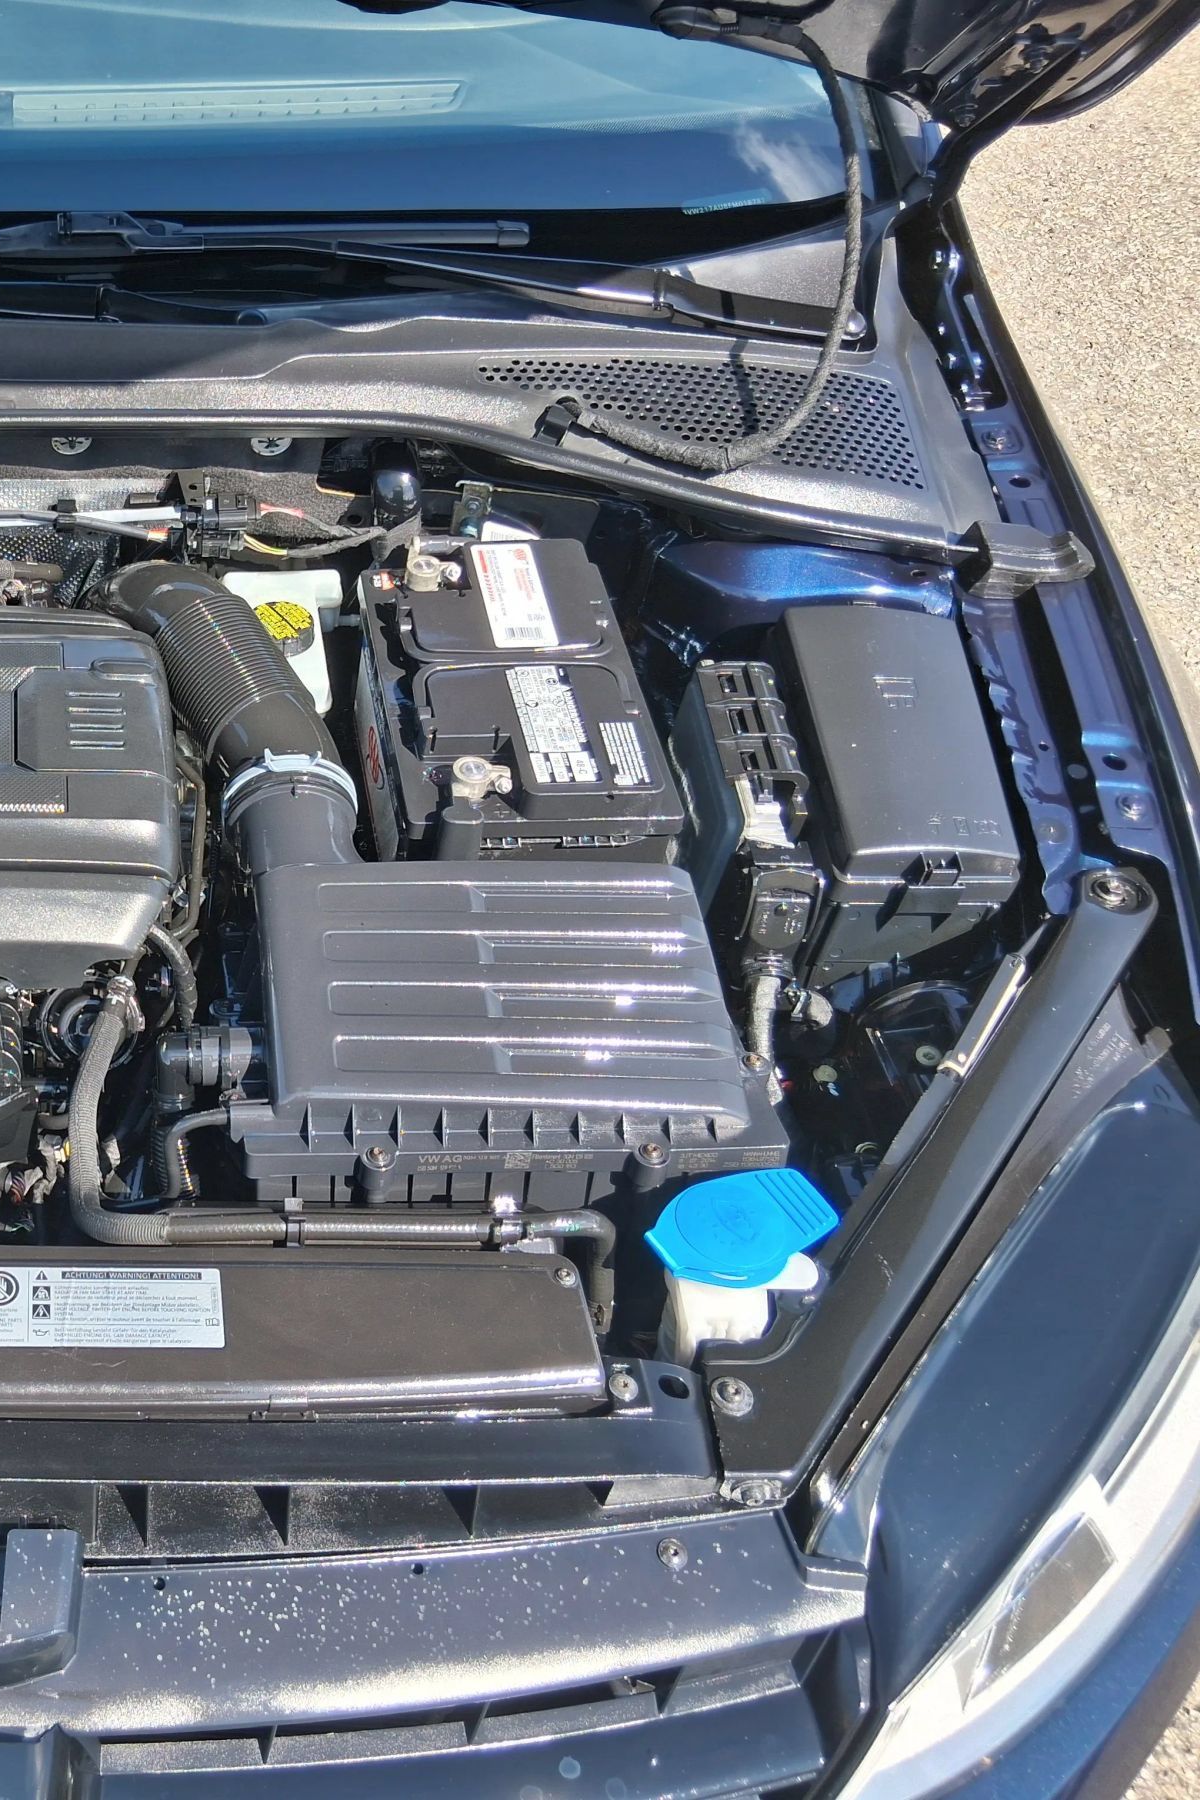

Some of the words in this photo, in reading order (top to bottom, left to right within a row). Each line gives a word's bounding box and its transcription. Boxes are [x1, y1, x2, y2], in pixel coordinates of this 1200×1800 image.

[64, 1271, 107, 1279] ACHTUNG!
[108, 1272, 151, 1280] WARNING!
[152, 1272, 200, 1280] ATTENTION!
